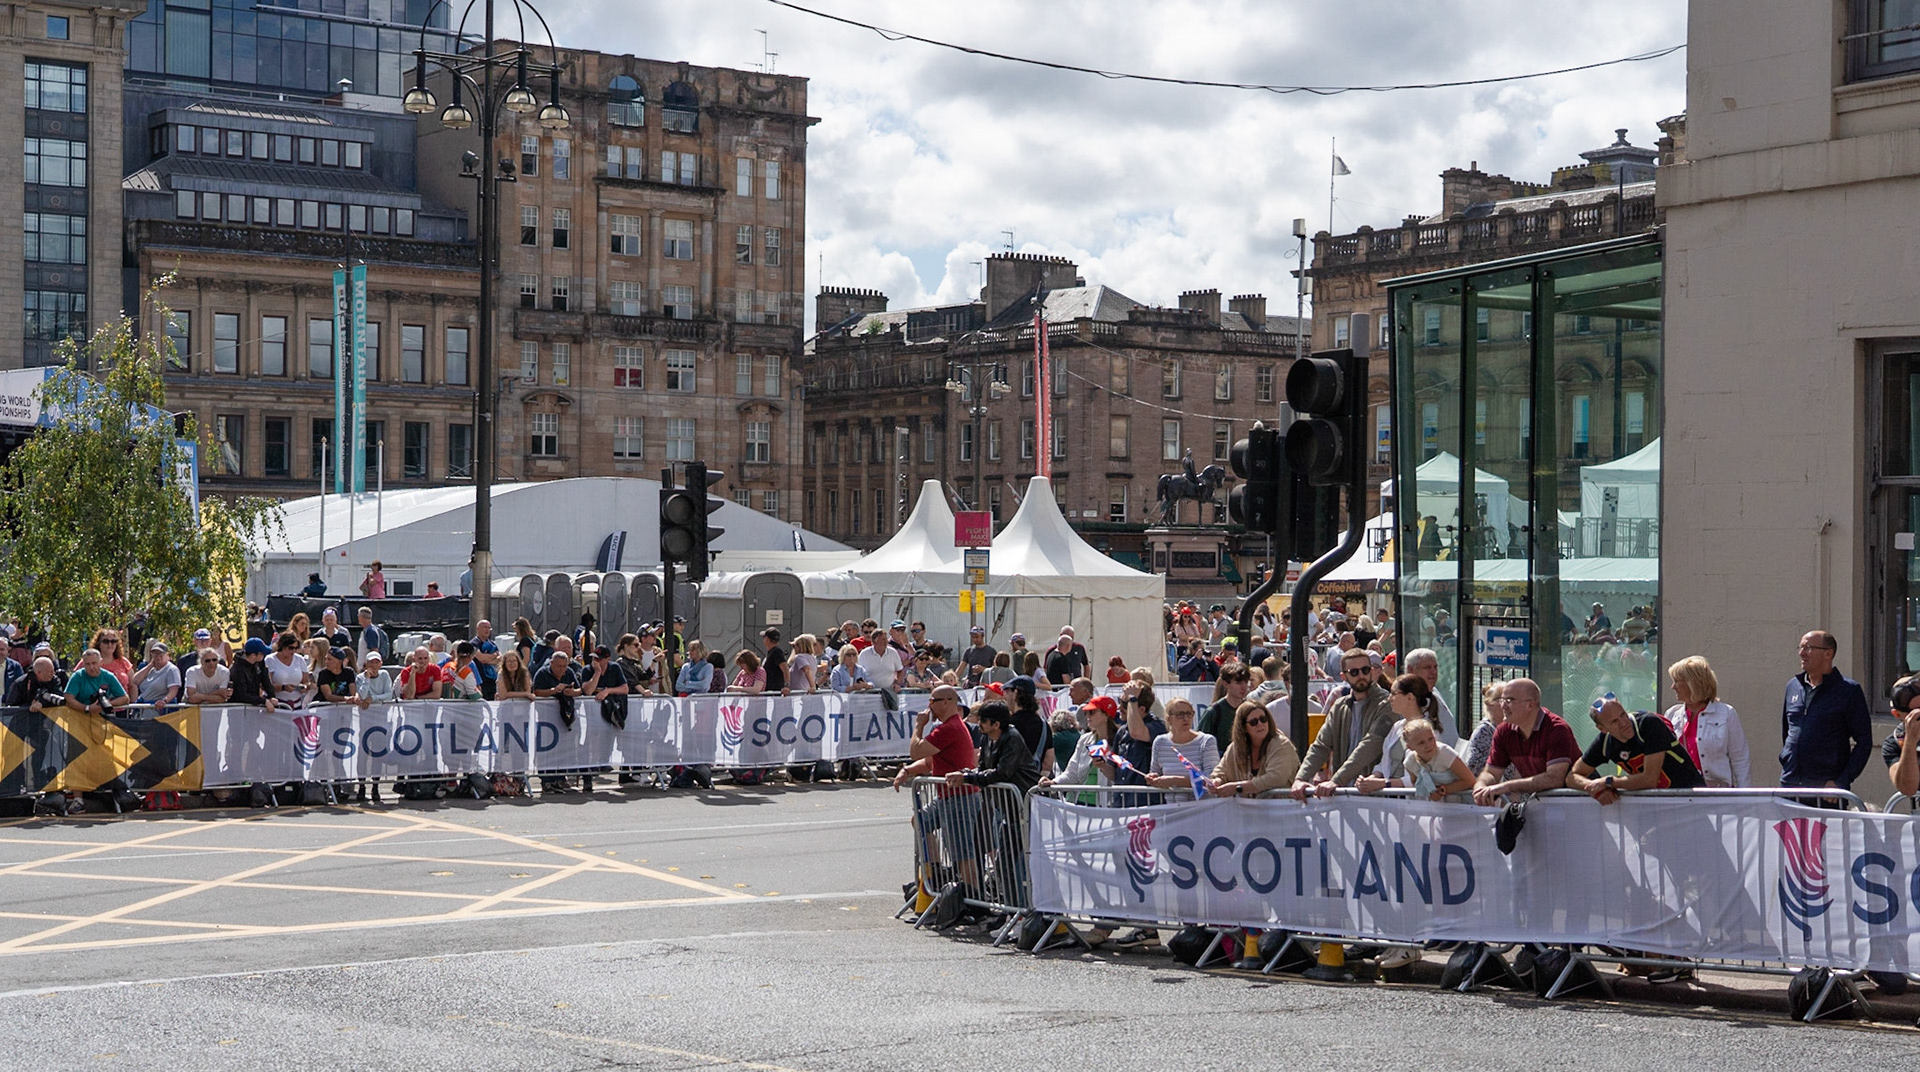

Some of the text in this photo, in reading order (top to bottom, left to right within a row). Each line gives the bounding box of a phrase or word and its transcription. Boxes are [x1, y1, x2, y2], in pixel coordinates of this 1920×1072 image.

[355, 280, 366, 450] MOUNTAIN BIKE
[8, 396, 31, 407] WORLD
[1317, 581, 1361, 593] Coffee Hut
[1509, 638, 1524, 647] exit
[332, 721, 559, 759] SCOTLAND
[1167, 836, 1475, 905] SCOTLAND
[1851, 852, 1920, 925] S
